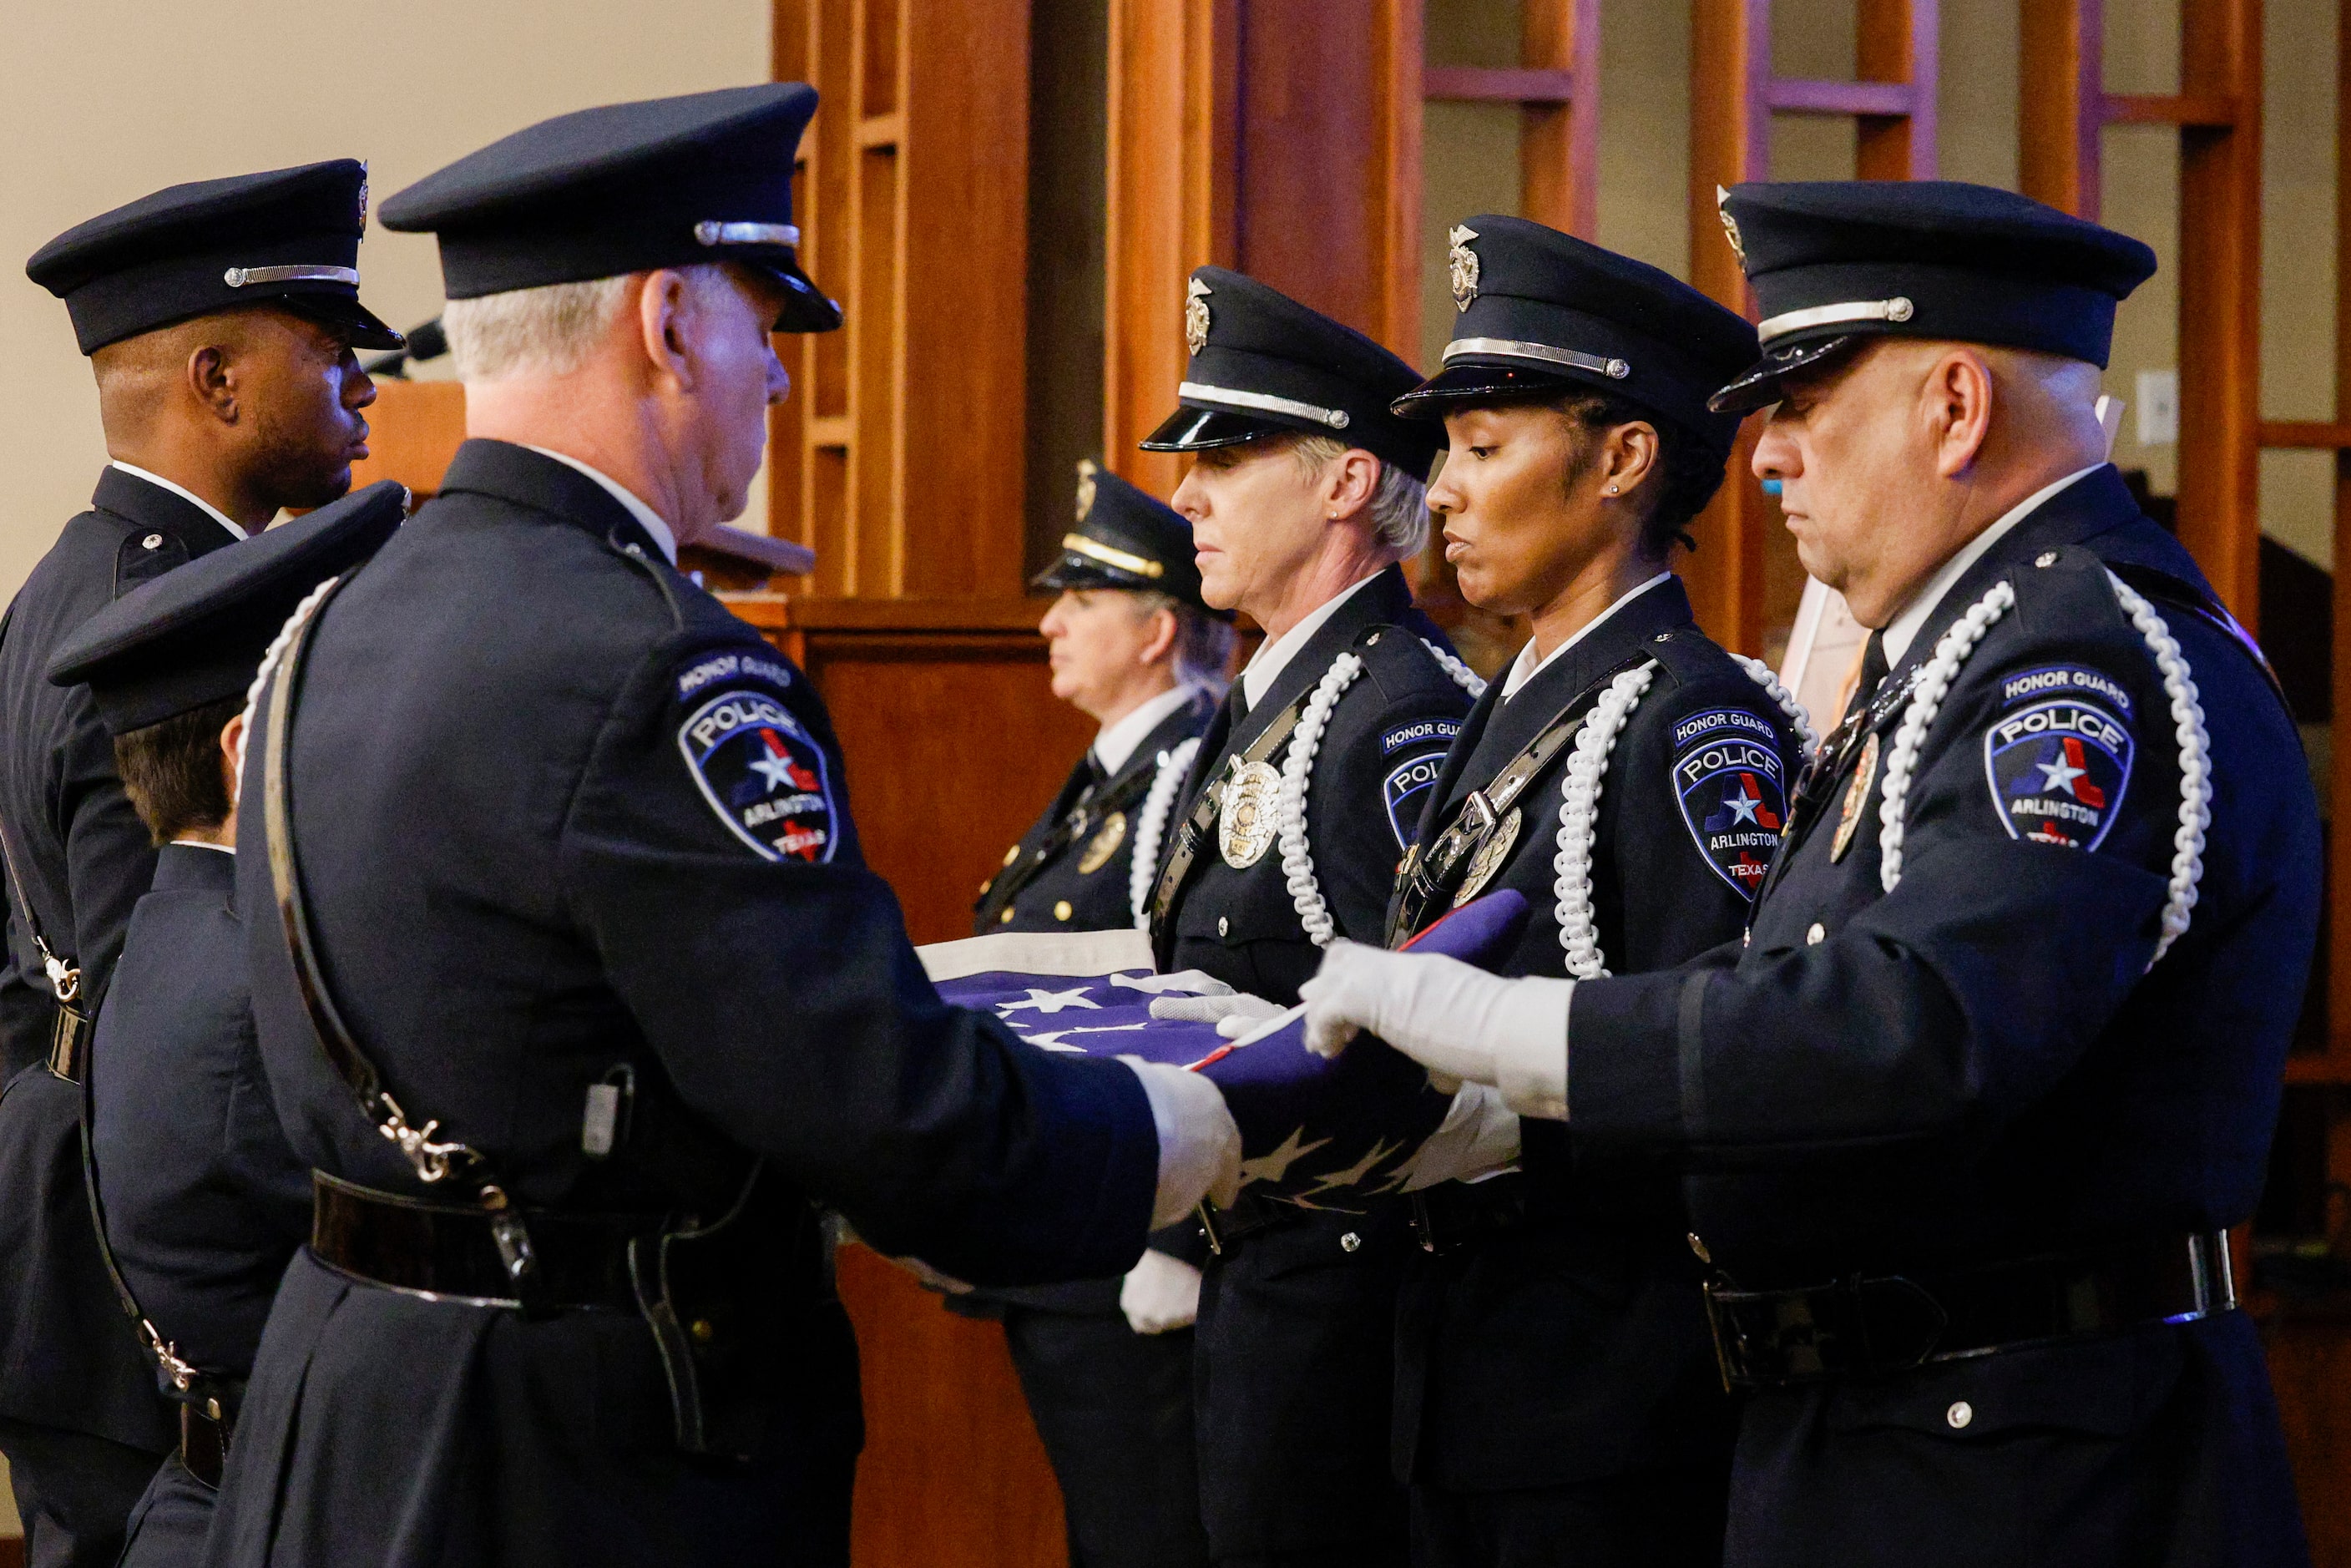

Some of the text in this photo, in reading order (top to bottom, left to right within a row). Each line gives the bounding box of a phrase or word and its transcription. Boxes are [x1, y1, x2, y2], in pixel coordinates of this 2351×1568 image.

[2005, 670, 2129, 709] HONOR GUARD
[1385, 723, 1433, 749] HONOR
[1676, 714, 1774, 741] HONOR GUARD
[2000, 709, 2125, 755] POLICE
[1683, 746, 1779, 783] POLICE
[2011, 798, 2100, 827] ARLINGTON
[1711, 832, 1779, 851] ARLINGTON
